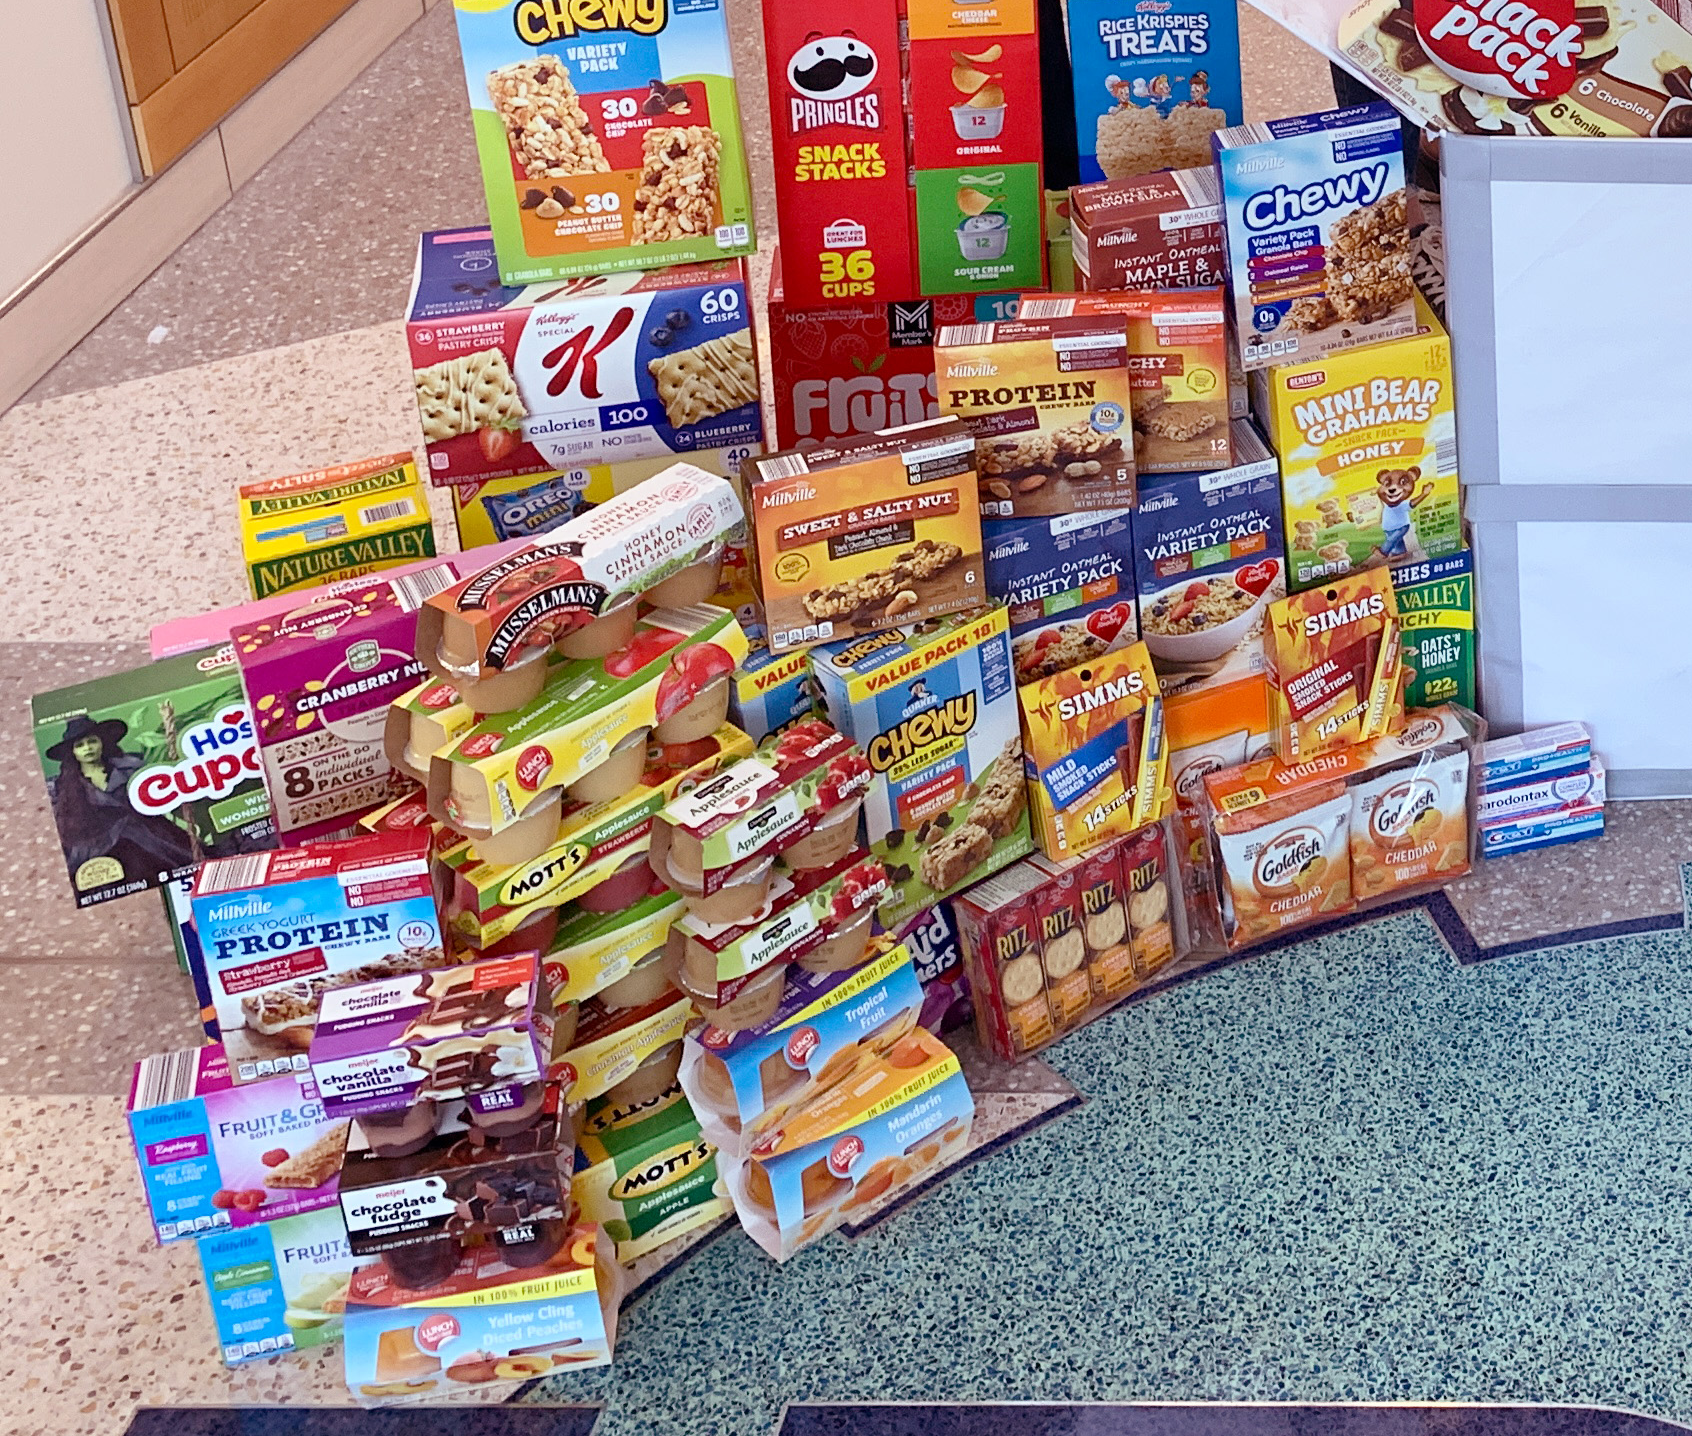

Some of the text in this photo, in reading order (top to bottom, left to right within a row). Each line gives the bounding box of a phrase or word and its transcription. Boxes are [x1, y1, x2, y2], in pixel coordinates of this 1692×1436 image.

[1099, 13, 1210, 34] RICE KRISPIES
[566, 42, 628, 57] VARIETY
[1102, 27, 1209, 58] TREATS
[1431, 5, 1552, 97] pack
[580, 58, 619, 74] PACK
[601, 97, 638, 119] 30
[791, 93, 879, 132] PRINGLES
[604, 117, 653, 131] CHOCOLATE
[605, 127, 627, 138] CHIP
[798, 143, 881, 164] SNACK
[956, 145, 1003, 155] ORIGINAL
[794, 160, 886, 182] STACKS
[1243, 164, 1388, 231] Chewy
[1097, 231, 1138, 247] Millville
[1251, 228, 1316, 249] Variety Pack
[819, 250, 875, 283] 36
[1125, 258, 1210, 284] MAPLE &
[700, 288, 739, 314] 60
[822, 281, 875, 299] CUPS
[436, 321, 505, 337] STRAWBERRY
[702, 311, 740, 324] CRISPS
[542, 306, 636, 399] K
[946, 361, 999, 380] Millville
[948, 380, 1097, 407] PROTEIN
[1295, 378, 1440, 430] MINI BEAR
[529, 406, 648, 436] calories 100
[694, 422, 751, 439] BLUEBERRY
[1307, 404, 1430, 446] GRAHAMS
[1337, 440, 1405, 467] HONEY
[503, 488, 573, 525] OREO
[783, 492, 953, 540] SWEET & SALTY NUT
[259, 528, 428, 595] NATURE VALLEY
[605, 522, 687, 575] CINNAMON
[491, 584, 599, 658] MUSSELMAN'S
[1304, 594, 1385, 637] SIMMS
[866, 620, 991, 691] VALUE PACK 18
[296, 668, 401, 713] CRANBERRY
[1287, 659, 1339, 694] ORIGINAL
[1314, 700, 1370, 740] 14 STICKS
[284, 765, 315, 799] 8
[317, 766, 375, 792] PACKS
[736, 809, 795, 853] Applesauce
[508, 847, 582, 901] MOTT'S
[1262, 838, 1323, 882] Goldfish
[208, 899, 272, 922] Millville
[1081, 878, 1115, 915] RITZ
[1269, 886, 1324, 913] CHEDDAR
[215, 913, 390, 960] PROTEIN
[845, 986, 889, 1025] Tropical
[859, 1007, 886, 1029] Fruit
[790, 1032, 815, 1057] LUNCH
[322, 1062, 405, 1086] chocolate
[335, 1073, 392, 1093] vanilla
[887, 1093, 943, 1134] Mandarin
[895, 1110, 943, 1145] Oranges
